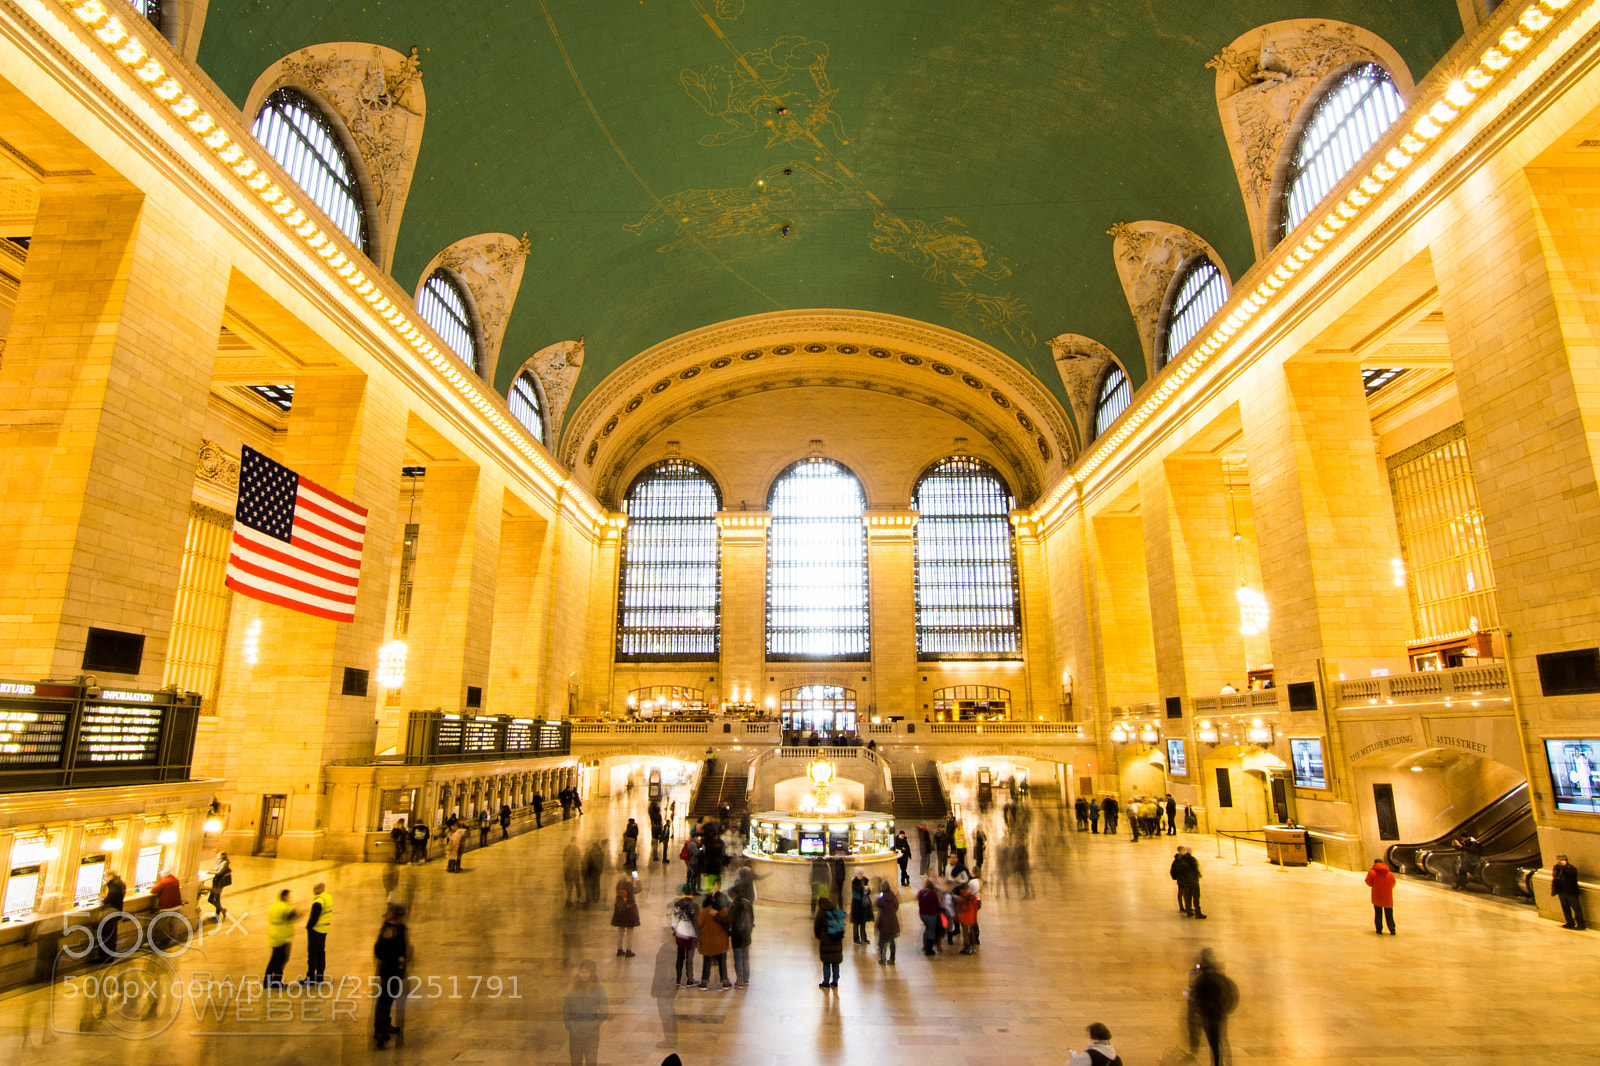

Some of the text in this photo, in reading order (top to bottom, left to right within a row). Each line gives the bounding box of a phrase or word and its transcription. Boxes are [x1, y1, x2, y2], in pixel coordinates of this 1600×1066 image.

[102, 690, 154, 702] INFORMATION
[1350, 735, 1413, 762] THE METLIFE BUILDING
[1436, 735, 1488, 754] 45TH STREET
